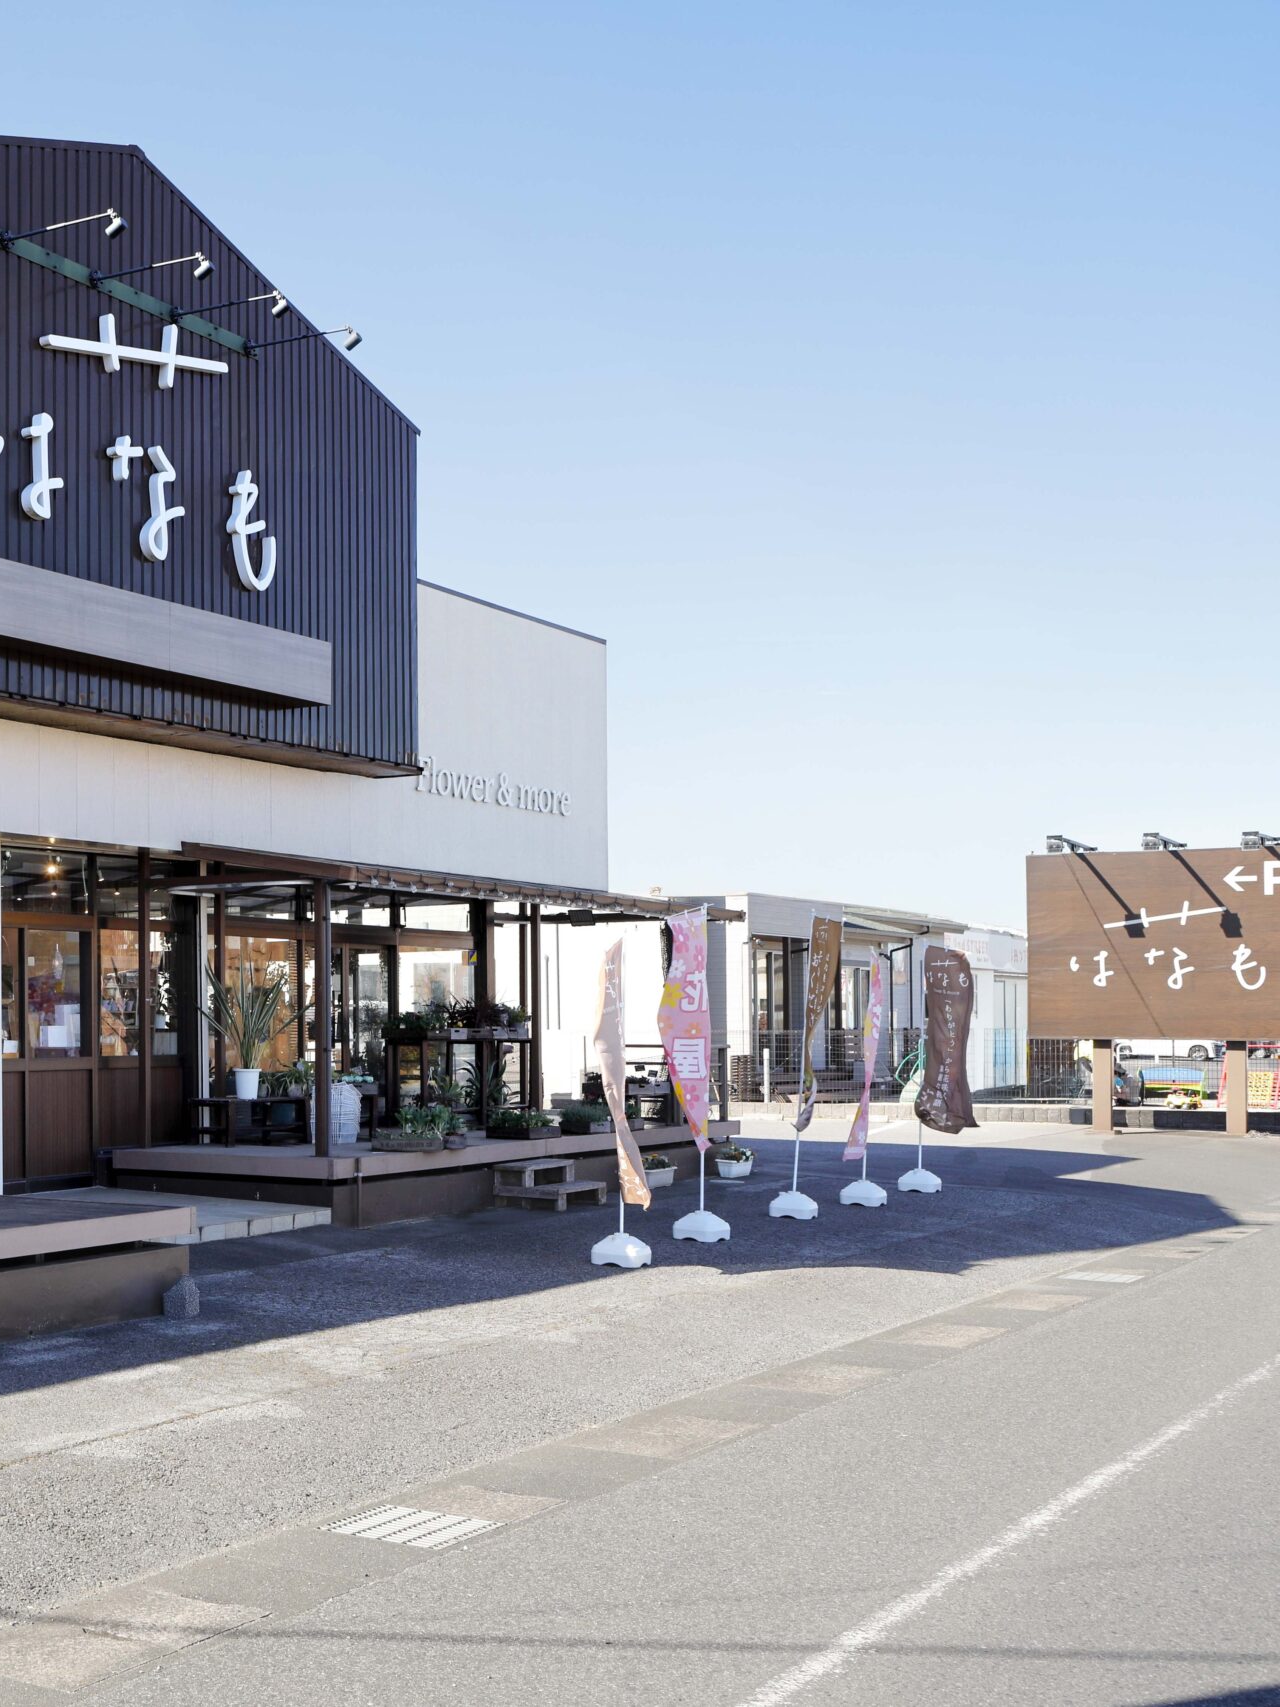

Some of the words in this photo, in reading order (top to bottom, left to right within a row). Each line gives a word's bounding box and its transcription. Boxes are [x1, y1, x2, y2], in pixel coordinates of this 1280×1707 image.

[417, 756, 494, 803] Flower
[496, 771, 515, 807] &
[518, 784, 571, 816] more
[1070, 944, 1267, 990] はなも
